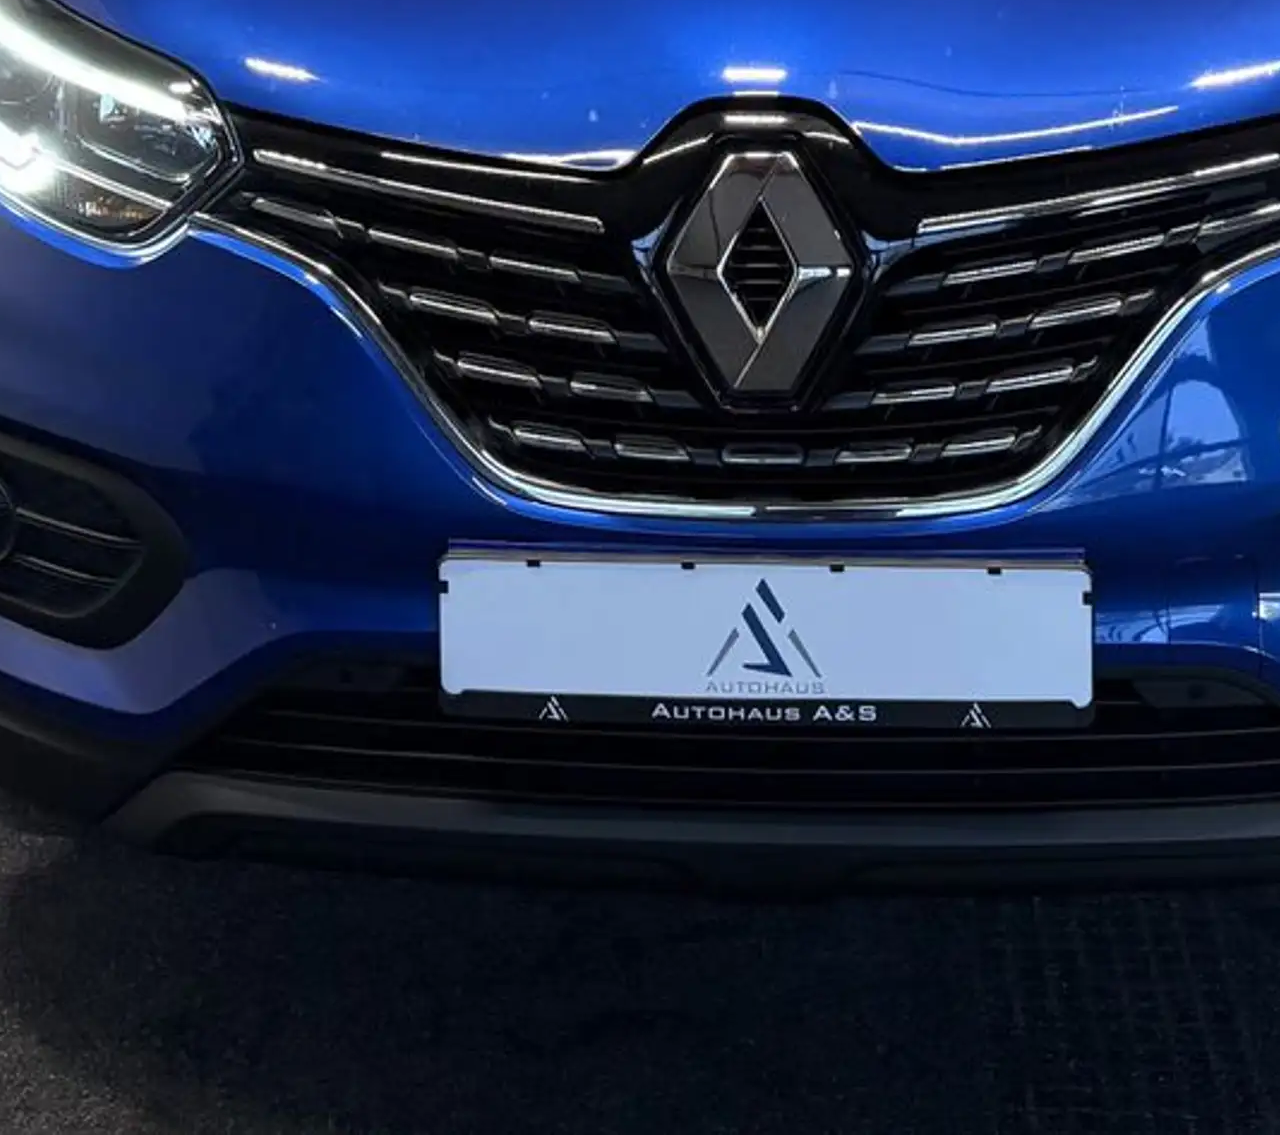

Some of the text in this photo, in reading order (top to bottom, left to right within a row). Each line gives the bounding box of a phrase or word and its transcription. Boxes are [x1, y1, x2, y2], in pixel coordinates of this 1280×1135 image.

[705, 679, 825, 695] AUTOHAUS
[651, 702, 878, 722] AUTOHAUS A&S
